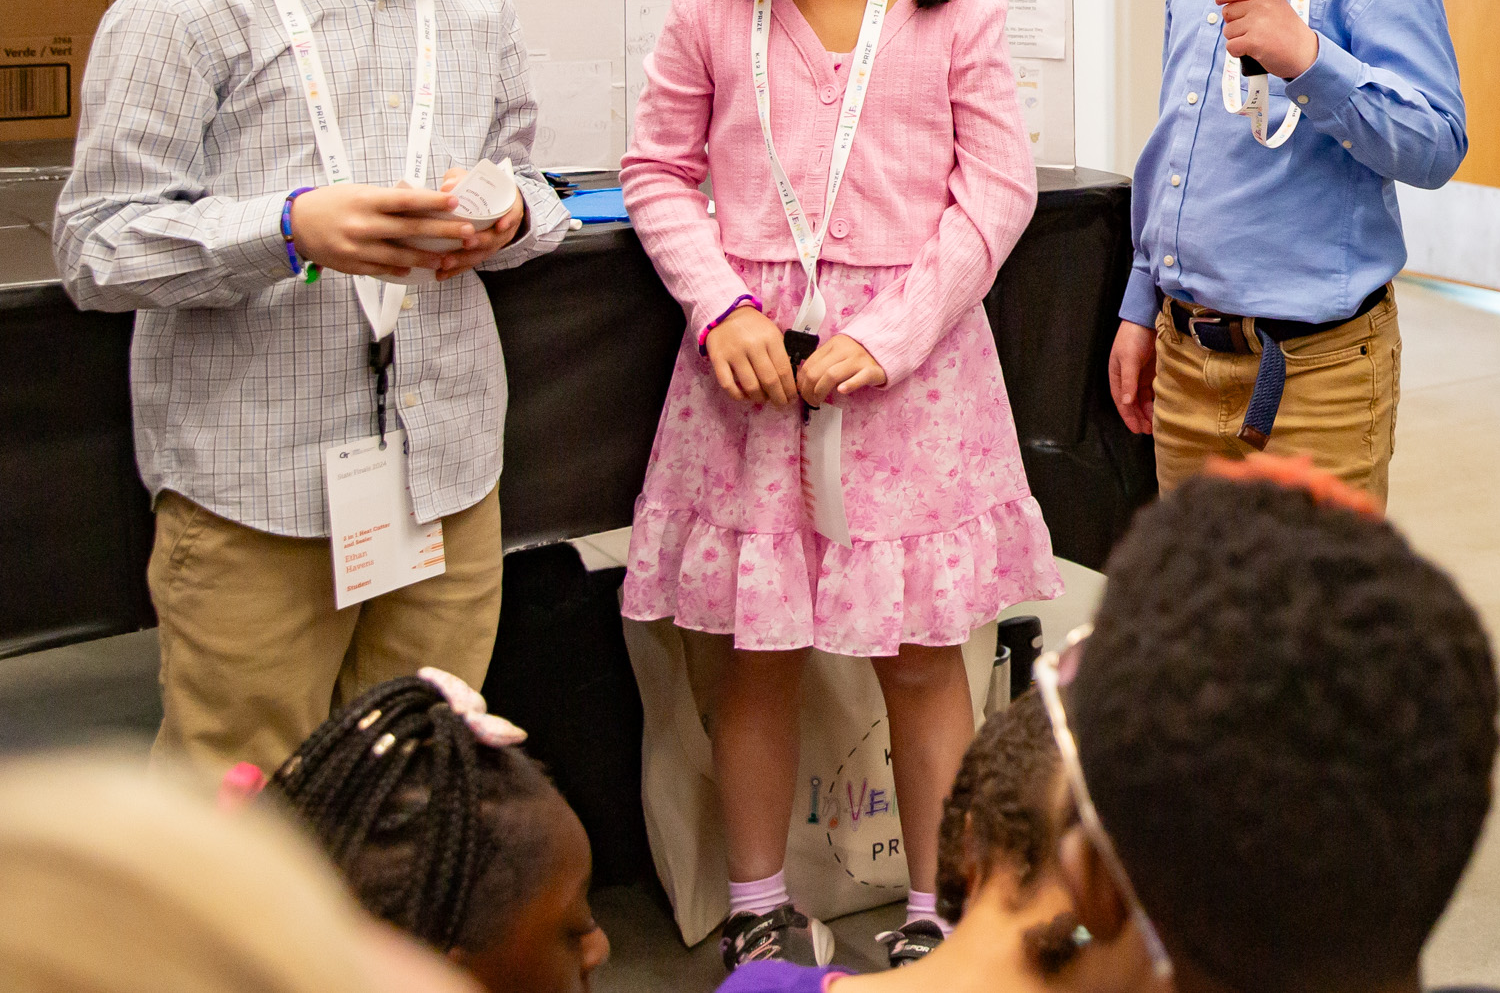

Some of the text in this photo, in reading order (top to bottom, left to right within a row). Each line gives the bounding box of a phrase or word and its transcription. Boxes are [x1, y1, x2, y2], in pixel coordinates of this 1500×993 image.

[757, 10, 765, 33] PRIZE
[871, 9, 881, 25] K-12
[4, 46, 72, 58] Verde / Vert
[862, 40, 873, 65] PRIZE
[314, 105, 330, 132] PRIZE
[419, 112, 428, 130] K-12
[841, 132, 850, 149] K-12
[328, 155, 341, 174] K-12
[414, 153, 424, 179] PRIZE
[372, 460, 388, 471] 2024
[359, 527, 372, 538] Heat
[372, 522, 391, 534] Cutter
[343, 535, 373, 549] and Sealer
[344, 550, 368, 563] Ethan
[345, 559, 375, 574] Havens
[346, 579, 372, 592] Student
